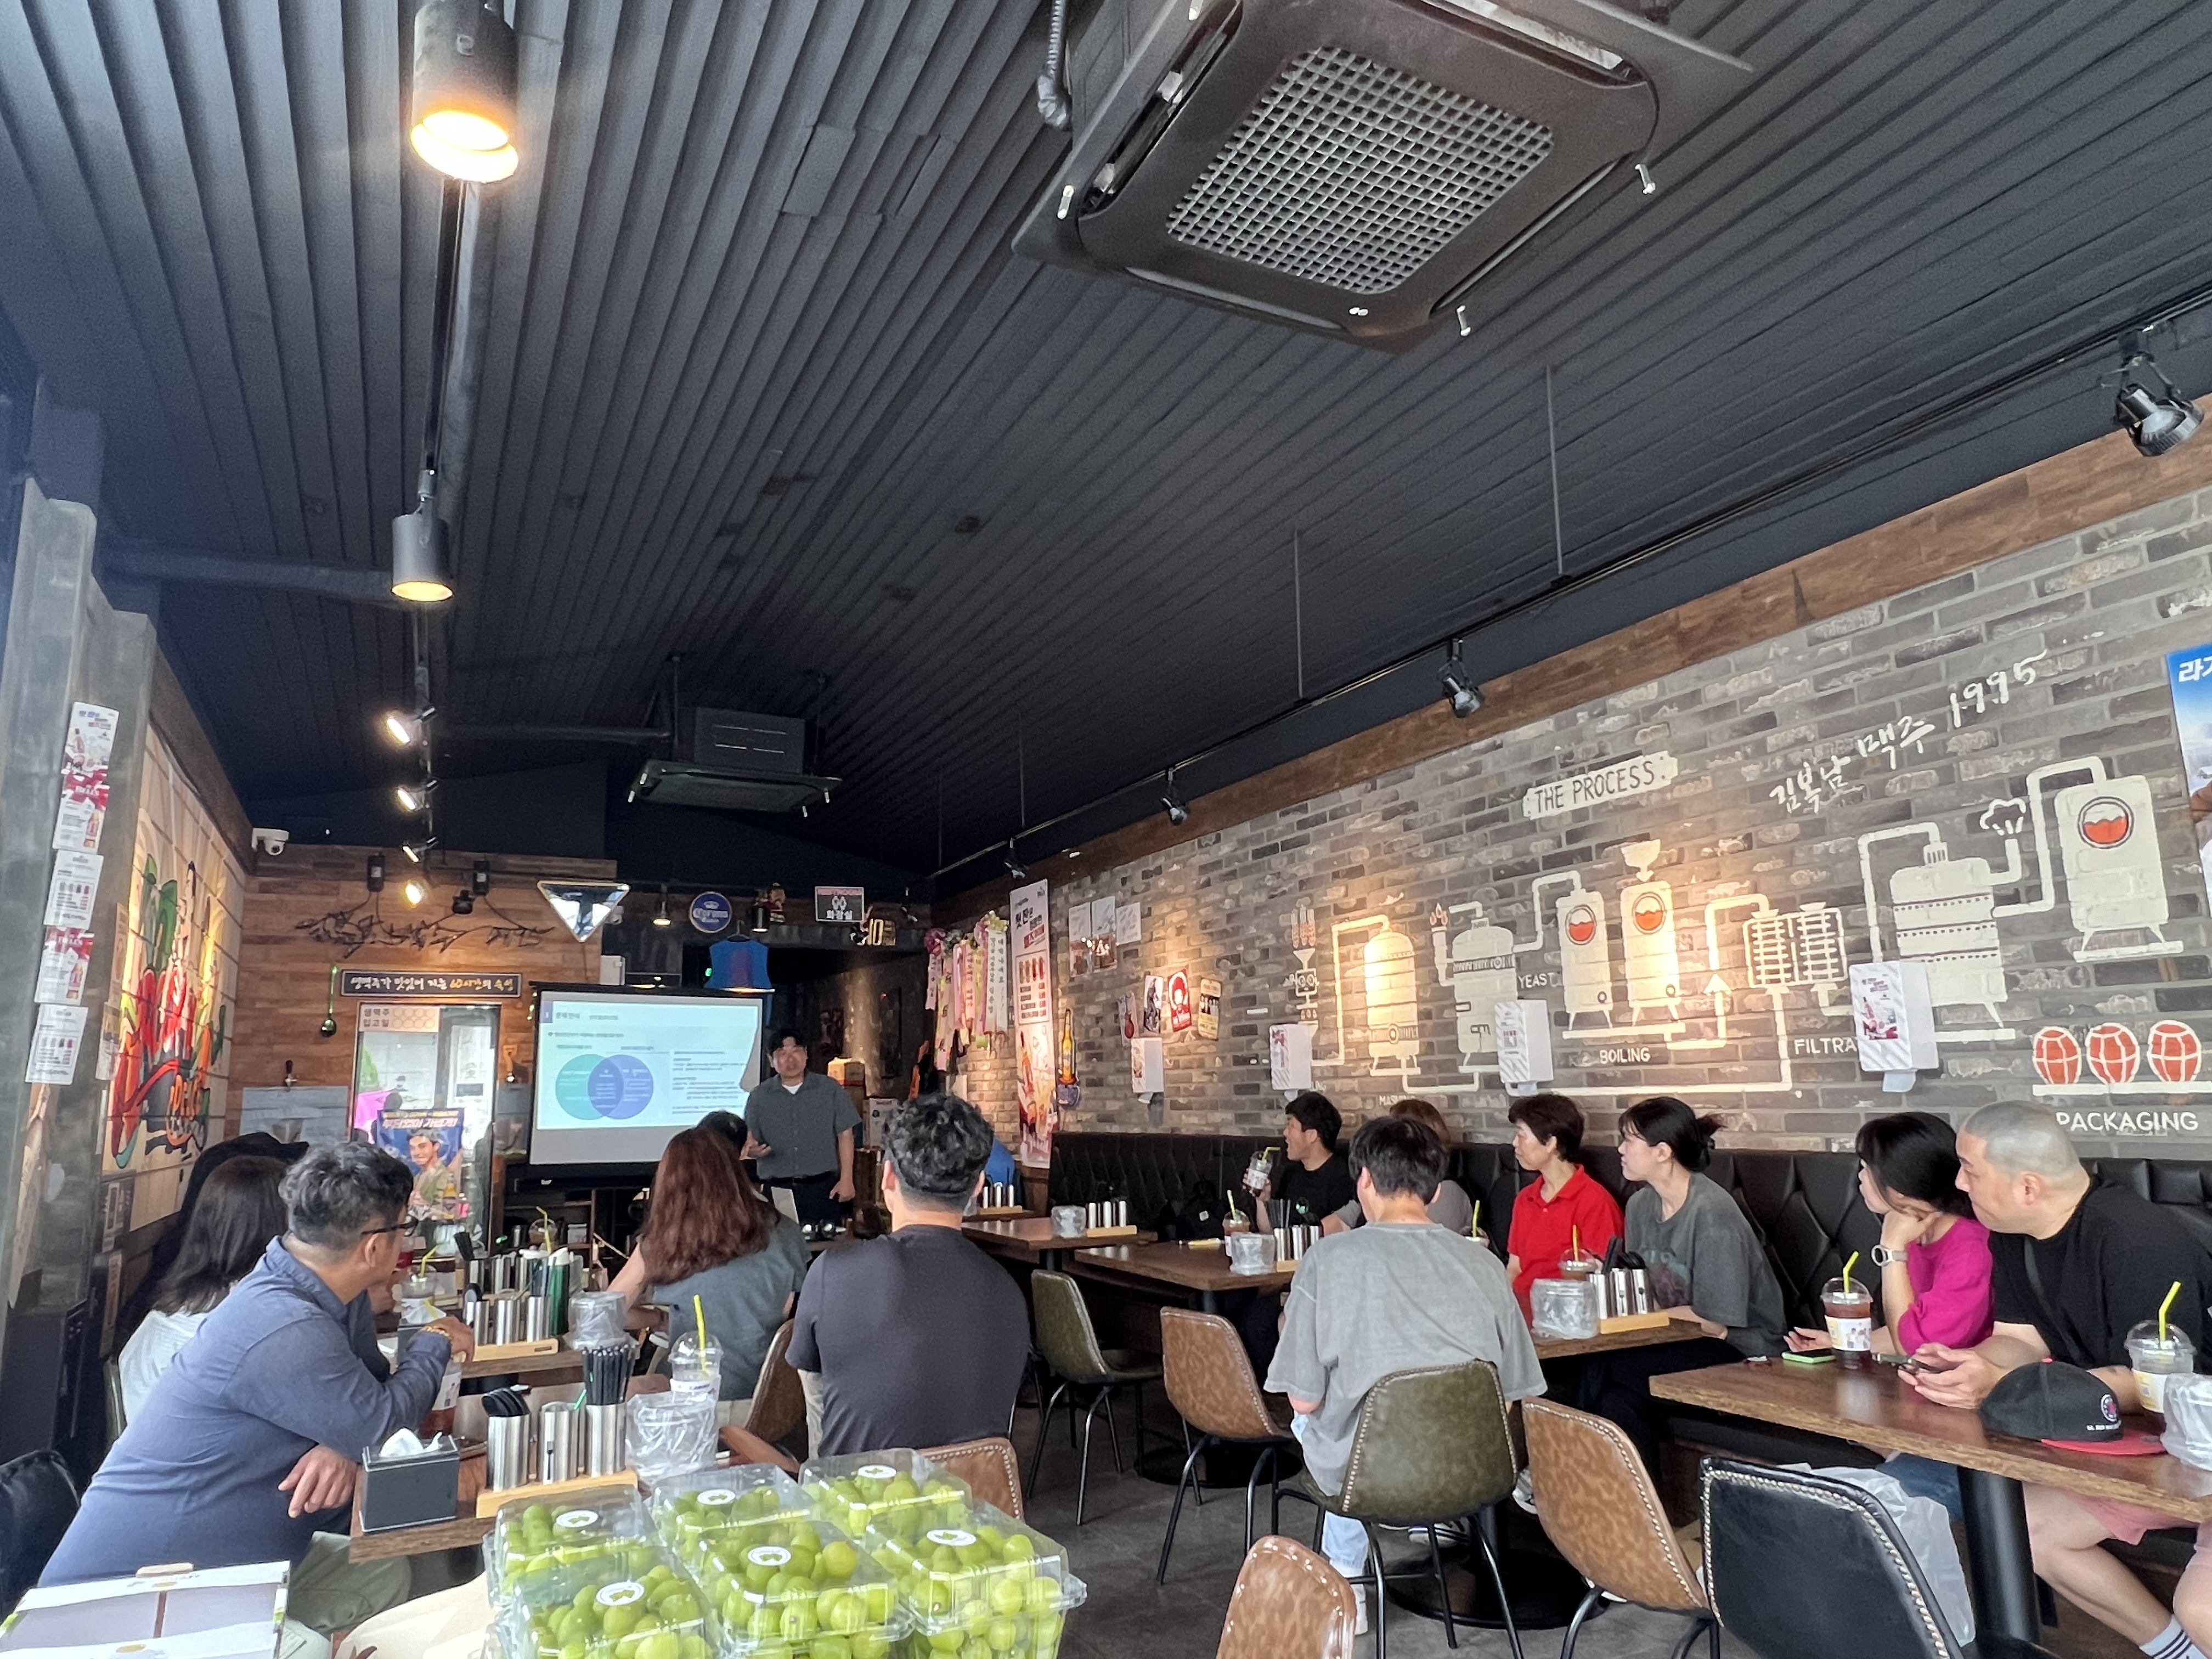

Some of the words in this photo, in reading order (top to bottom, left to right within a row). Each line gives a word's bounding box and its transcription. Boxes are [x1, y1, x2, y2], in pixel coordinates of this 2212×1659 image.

[1949, 649, 2048, 728] 1995
[1534, 785, 1564, 813] THE
[1572, 760, 1655, 804] PROCESS
[826, 910, 853, 919] 화장실
[350, 977, 392, 990] 생맥주가
[394, 977, 424, 991] 맛있어
[427, 977, 447, 990] 지는
[494, 978, 514, 991] 숙성
[1517, 972, 1556, 989] YEAST
[364, 1008, 390, 1017] 생맥주
[1794, 1037, 1858, 1055] FILTRA
[1599, 1047, 1651, 1064] BOILING
[2056, 1111, 2199, 1131] PACKAGING
